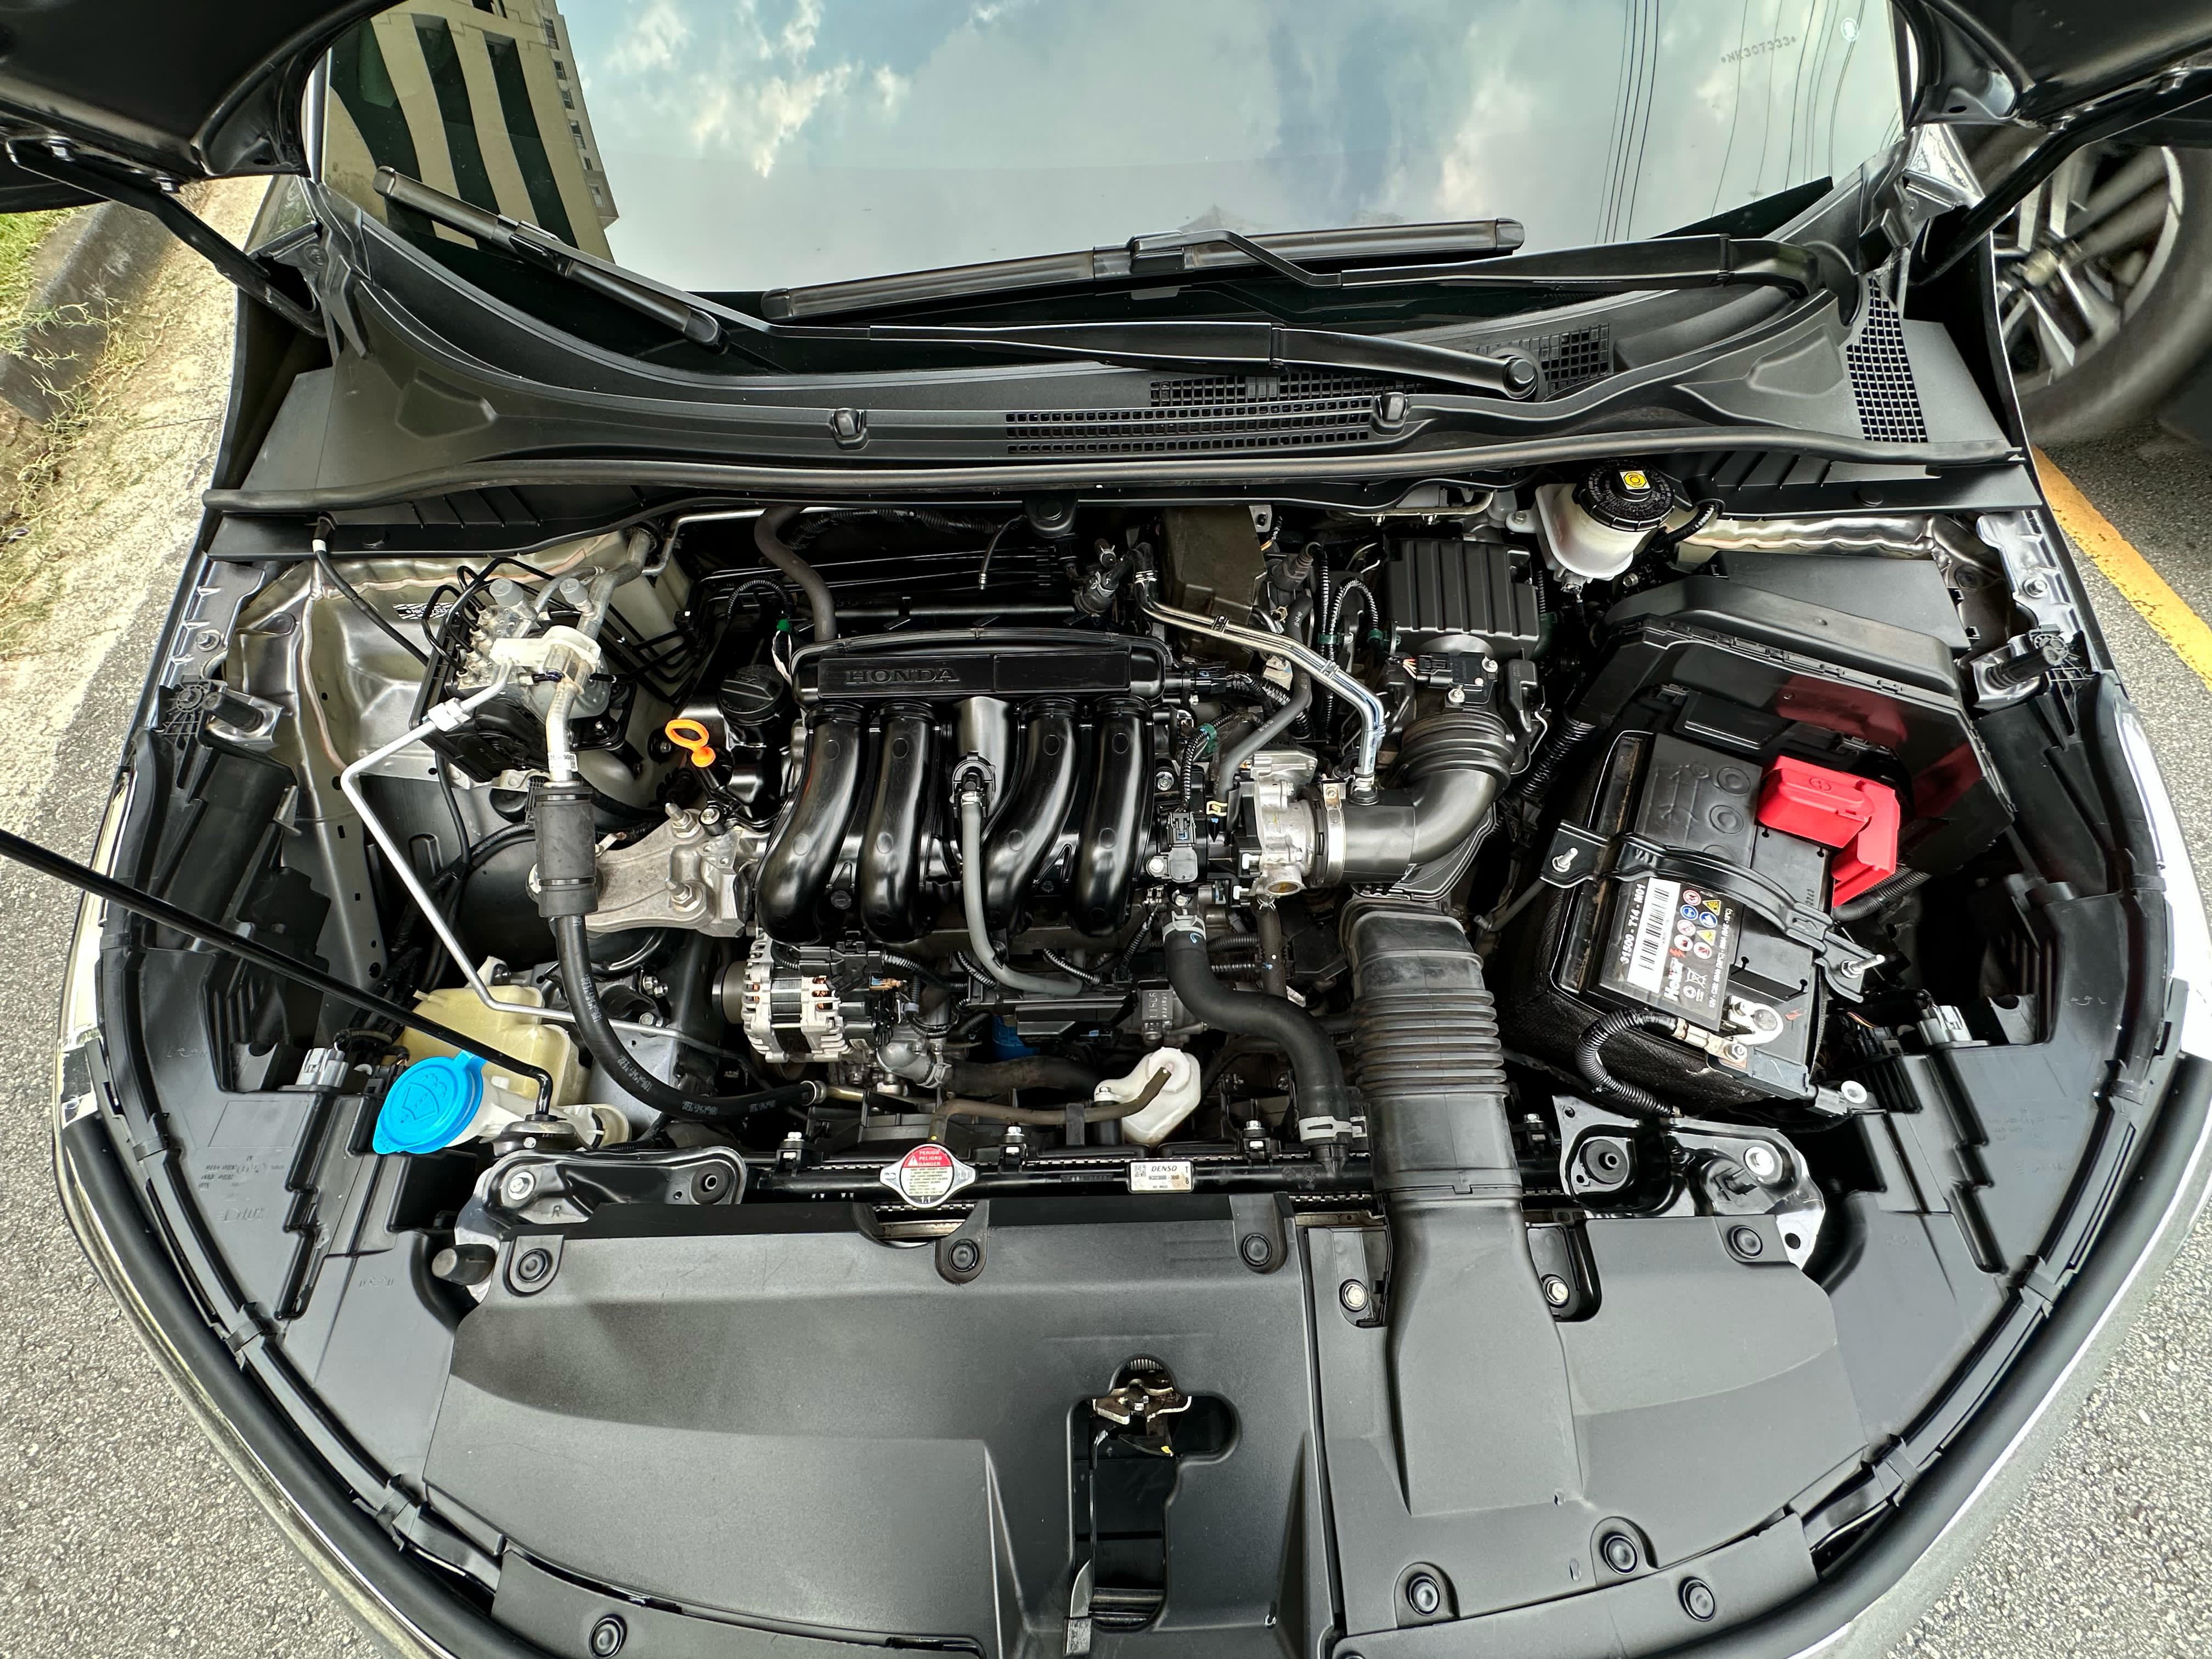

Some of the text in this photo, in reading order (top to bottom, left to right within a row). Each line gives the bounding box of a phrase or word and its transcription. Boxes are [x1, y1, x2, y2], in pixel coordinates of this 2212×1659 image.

[845, 668, 960, 684] HONDA
[1633, 884, 1646, 904] M01
[1628, 909, 1640, 927] T14
[1620, 934, 1635, 964] 31500
